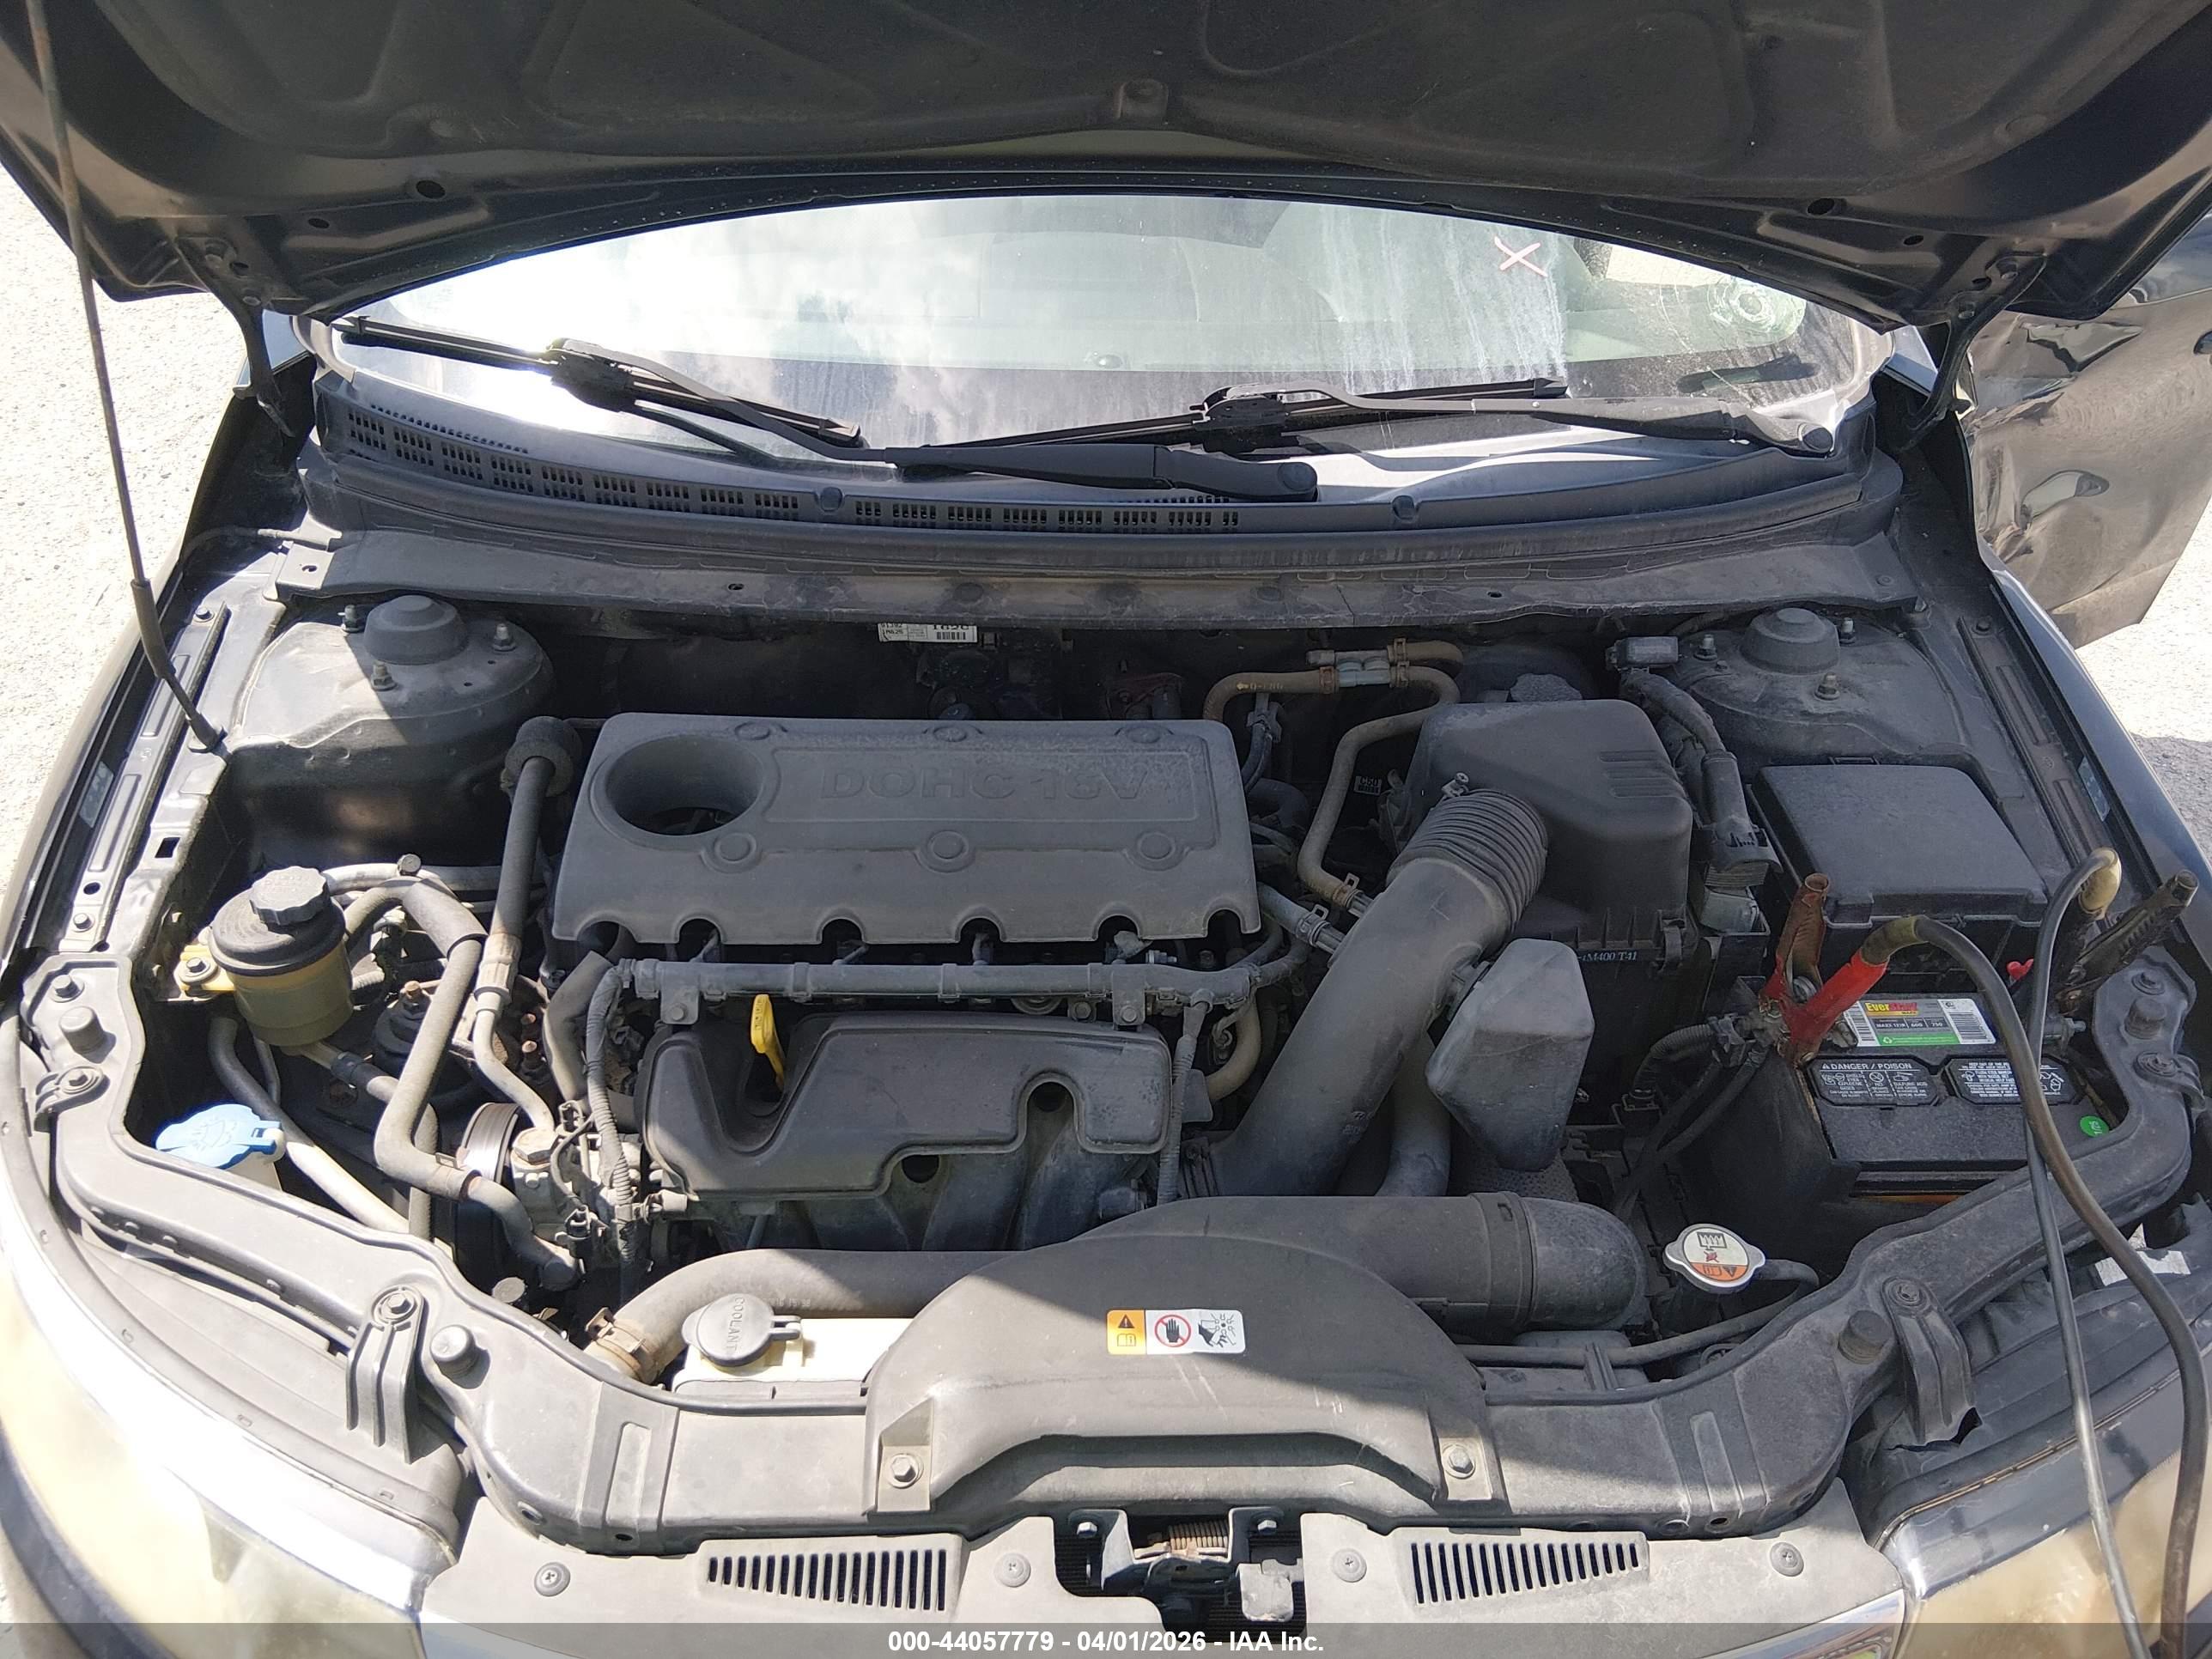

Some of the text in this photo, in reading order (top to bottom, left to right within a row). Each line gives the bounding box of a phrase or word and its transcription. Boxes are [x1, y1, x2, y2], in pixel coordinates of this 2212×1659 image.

[820, 767, 1149, 800] DOHC 16V
[726, 1297, 745, 1351] COOLANT
